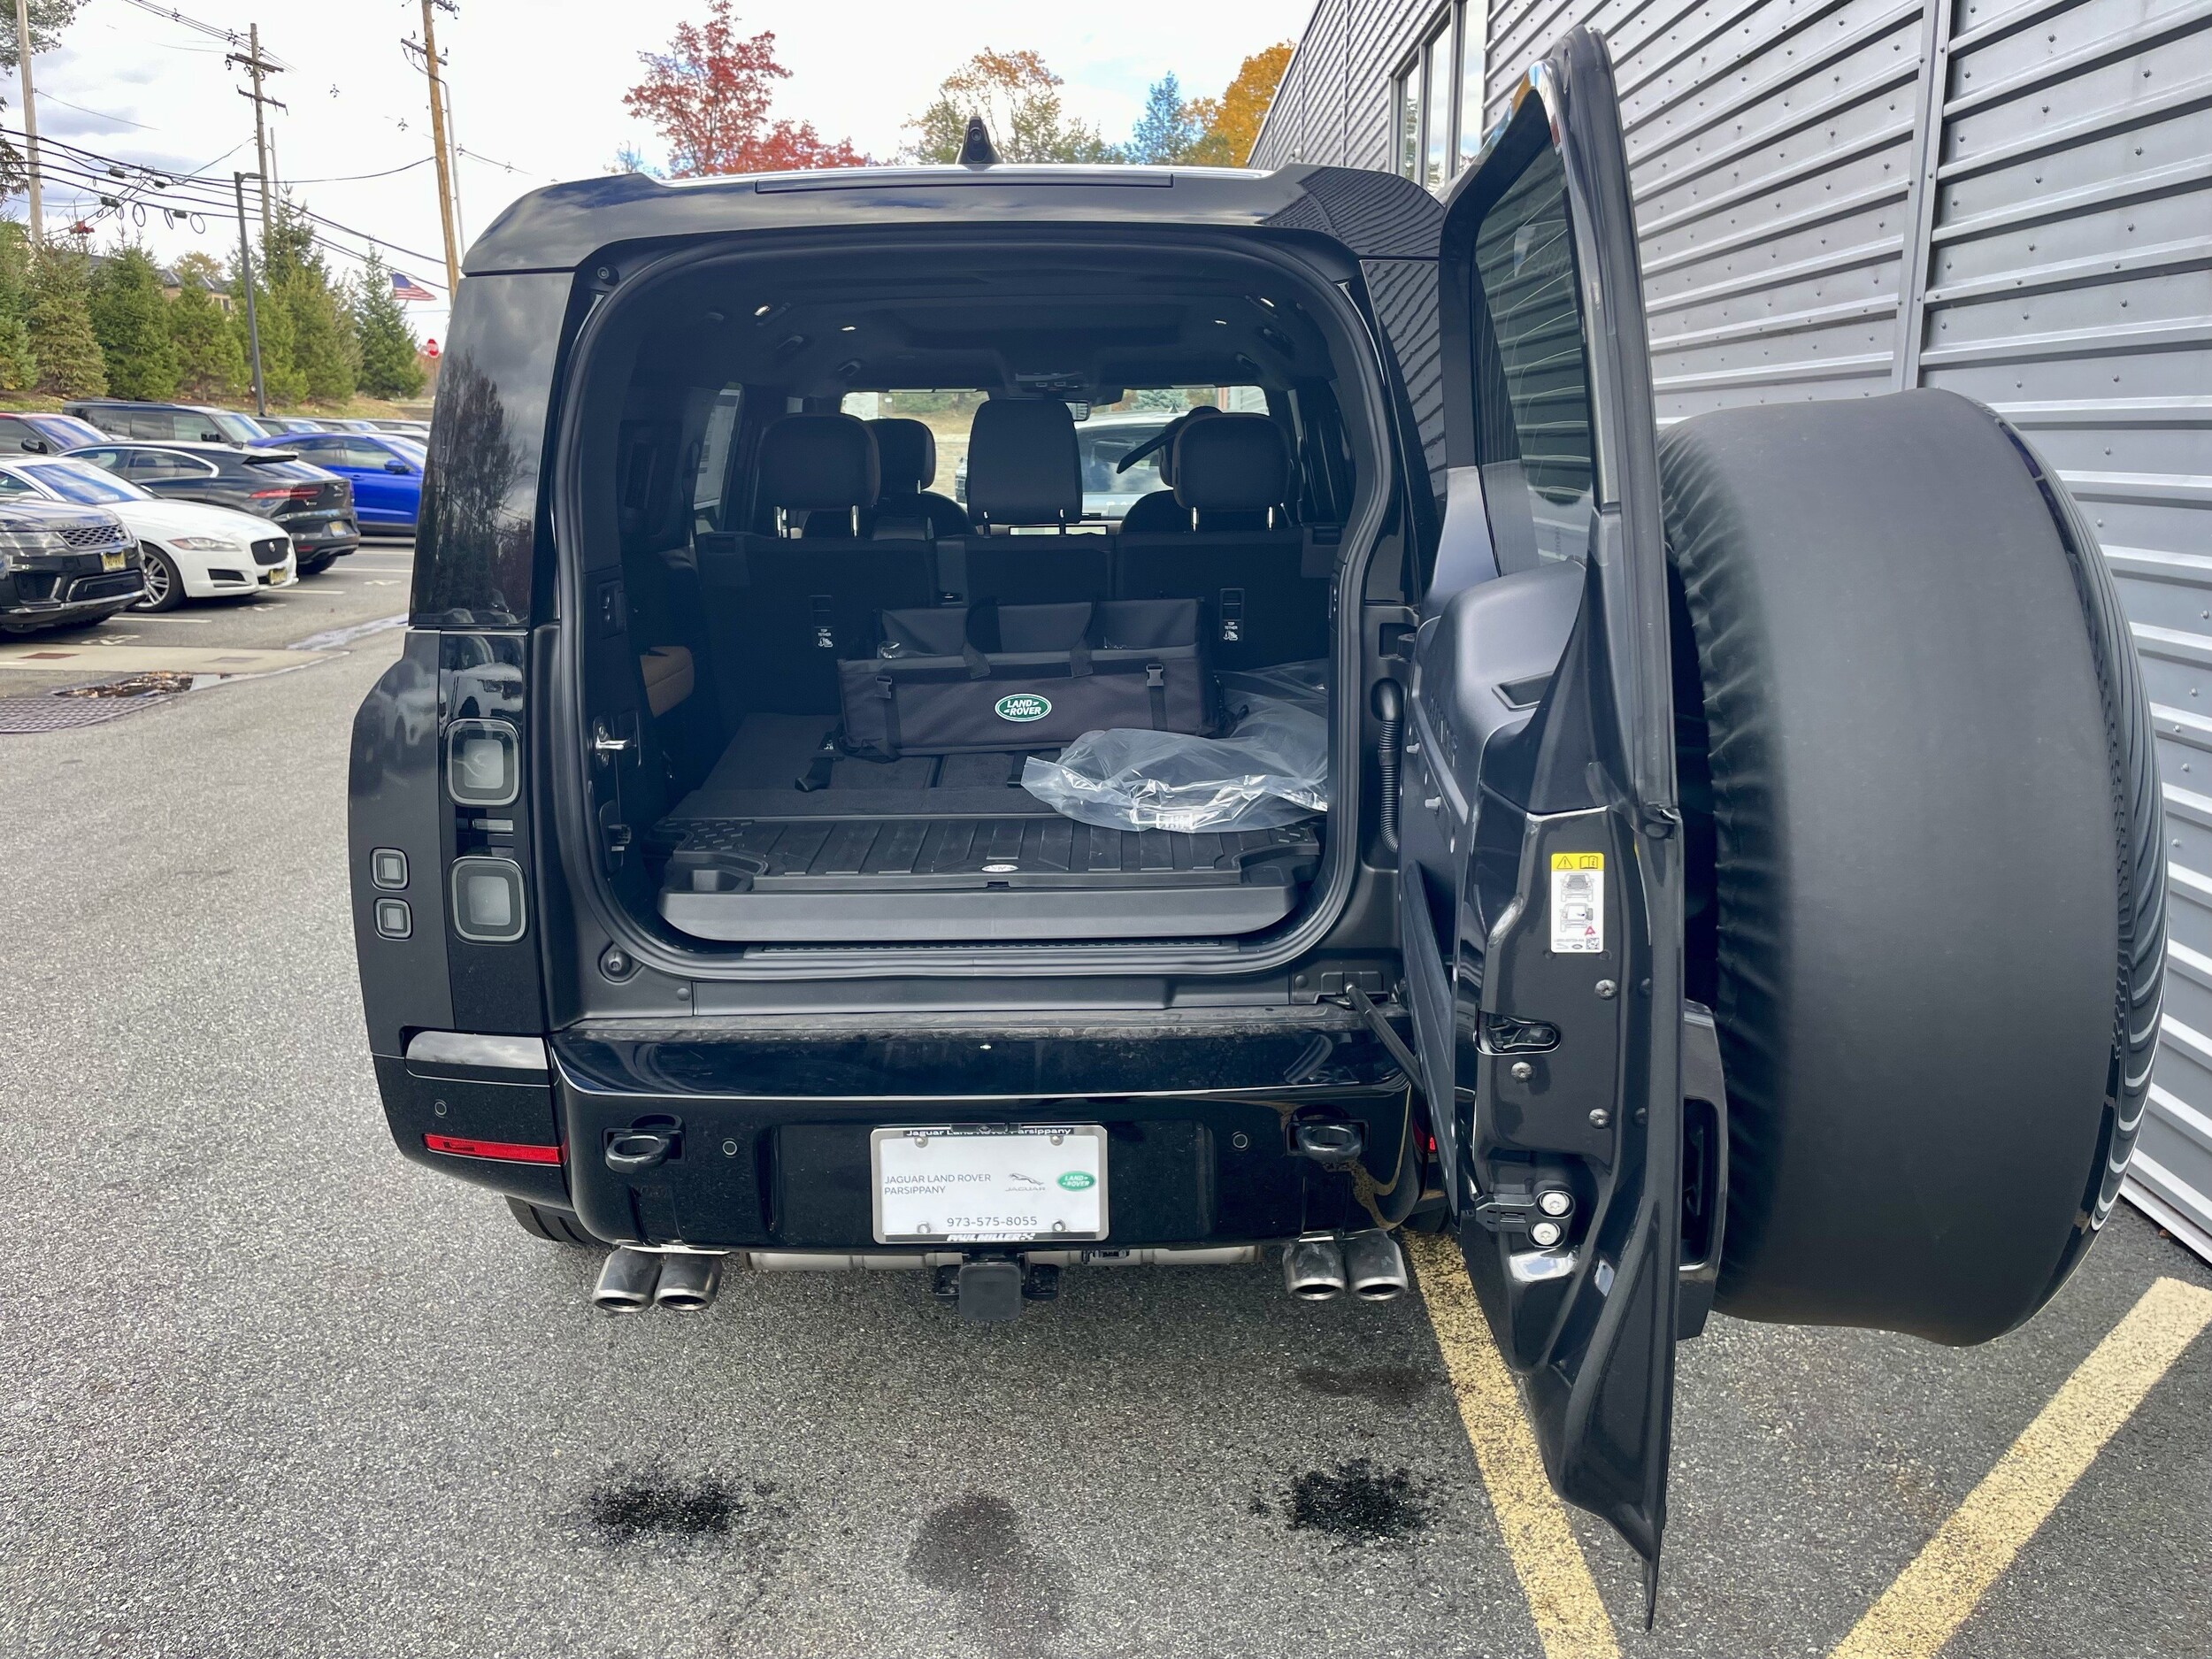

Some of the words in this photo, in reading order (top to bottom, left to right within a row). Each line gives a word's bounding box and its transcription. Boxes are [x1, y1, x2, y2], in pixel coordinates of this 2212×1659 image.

[1007, 699, 1033, 708] LAND
[1009, 707, 1041, 716] ROVER
[885, 1175, 925, 1184] JAGUAR
[927, 1174, 956, 1183] LAND
[957, 1173, 991, 1182] ROVER
[885, 1186, 946, 1195] PARSIPPANY
[947, 1217, 1038, 1227] 973-575-8055
